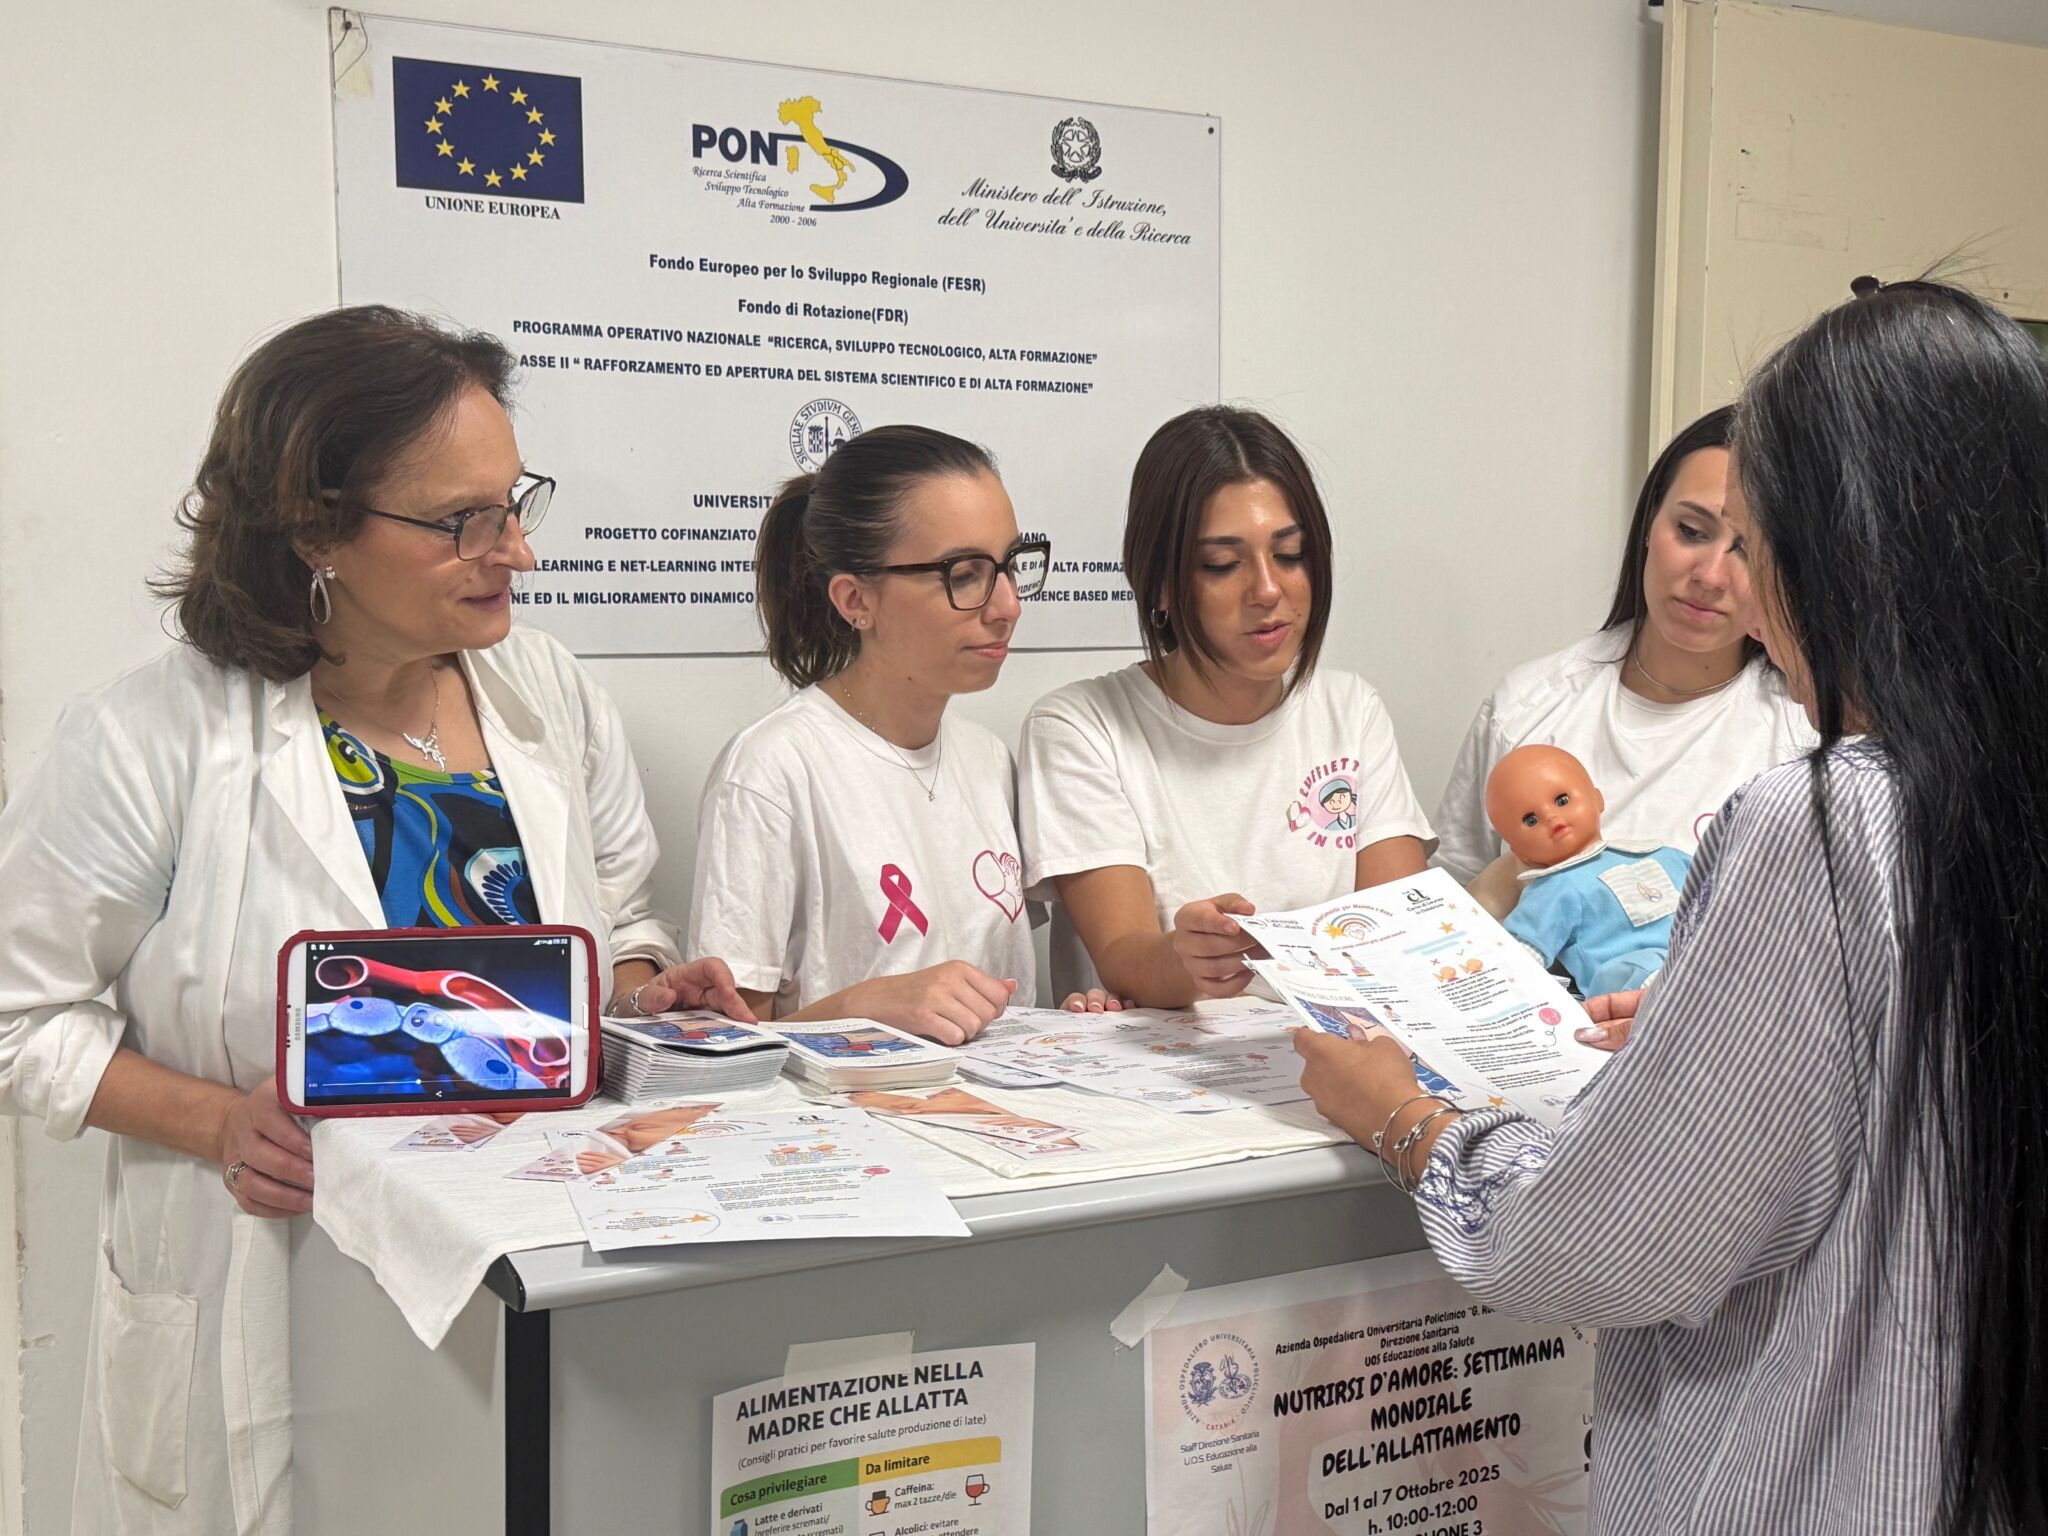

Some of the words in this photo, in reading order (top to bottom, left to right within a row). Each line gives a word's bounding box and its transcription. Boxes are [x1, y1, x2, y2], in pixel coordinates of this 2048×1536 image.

[692, 123, 778, 166] PON
[693, 166, 722, 178] Ricerca
[724, 169, 767, 183] Scientifica
[704, 181, 741, 196] Sviluppo
[743, 184, 789, 199] Tecnologico
[961, 178, 1038, 203] Ministero
[1082, 189, 1166, 217] Istruzione,
[425, 196, 484, 214] UNIONE
[488, 201, 561, 220] EUROPEA
[737, 198, 756, 209] Alta
[758, 200, 805, 212] Formazione
[770, 215, 790, 225] 2000
[797, 217, 817, 227] 2006
[1074, 226, 1082, 236] e
[1086, 220, 1125, 240] della
[1129, 221, 1191, 245] Ricerca
[649, 254, 694, 271] Fondo
[699, 258, 759, 280] Europeo
[763, 265, 786, 281] per
[791, 266, 804, 279] lo
[808, 266, 867, 287] Sviluppo
[871, 271, 938, 290] Regionale
[942, 276, 986, 295] (FESR)
[738, 299, 781, 316] Fondo
[785, 302, 798, 317] di
[803, 303, 909, 326] Rotazione(FDR)
[513, 320, 603, 337] PROGRAMMA
[607, 326, 682, 342] OPERATIVO
[687, 331, 761, 347] NAZIONALE
[836, 339, 895, 354] SVILUPPO
[898, 343, 985, 361] TECNOLOGICO,
[989, 346, 1017, 360] ALTA
[520, 355, 555, 368] ASSE
[584, 358, 701, 375] RAFFORZAMENTO
[705, 362, 722, 376] ED
[726, 363, 794, 381] APERTURA
[797, 367, 821, 382] DEL
[825, 368, 877, 385] SISTEMA
[881, 371, 955, 390] SCIENTIFICO
[959, 376, 967, 389] E
[970, 377, 982, 390] DI
[985, 378, 1013, 392] ALTA
[792, 420, 807, 464] SICILIAE
[801, 401, 841, 420] STVDIVM
[585, 527, 656, 540] PROGETTO
[661, 528, 757, 541] COFINANZIATO
[608, 560, 616, 571] E
[620, 560, 717, 573] NET-LEARNING
[1052, 561, 1079, 573] ALTA
[534, 592, 552, 604] ED
[557, 592, 569, 604] IL
[573, 591, 687, 605] MIGLIORAMENTO
[690, 592, 755, 604] DINAMICO
[1073, 590, 1108, 602] BASED
[1306, 831, 1328, 848] IN
[1335, 833, 1357, 849] CO
[1275, 1338, 1311, 1355] Azienda
[1313, 1329, 1364, 1349] Ospedaliera
[1367, 1317, 1422, 1337] Universitaria
[1425, 1309, 1466, 1326] Policlinico
[1380, 1333, 1421, 1349] Direzione
[1422, 1325, 1459, 1341] Sanitaria
[1365, 1355, 1381, 1367] UOS
[1383, 1345, 1429, 1364] Educazione
[1432, 1340, 1447, 1354] alla
[1449, 1335, 1475, 1351] Salute
[1273, 1377, 1365, 1417] NUTRIRSI
[1370, 1357, 1458, 1397] D'AMORE:
[1463, 1336, 1565, 1378] SETTIMANA
[736, 1373, 909, 1421] ALIMENTAZIONE
[914, 1360, 983, 1385] NELLA
[747, 1410, 824, 1445] MADRE
[830, 1402, 871, 1426] CHE
[876, 1388, 968, 1419] ALLATTA
[1371, 1387, 1473, 1431] MONDIALE
[738, 1445, 776, 1470] (Consigli
[778, 1441, 808, 1459] pratici
[811, 1441, 826, 1455] per
[829, 1434, 865, 1449] favorire
[867, 1428, 896, 1441] salute
[898, 1419, 950, 1437] produzione
[953, 1416, 963, 1427] di
[964, 1414, 986, 1427] late)
[1180, 1443, 1198, 1453] Staff
[1198, 1437, 1230, 1450] Direzione
[1231, 1431, 1260, 1442] Sanitaria
[1206, 1447, 1245, 1461] Educazione
[1246, 1444, 1258, 1454] alla
[1322, 1412, 1521, 1477] DELL'ALLATTAMENTO
[865, 1463, 881, 1475] Da
[885, 1454, 929, 1472] limitare
[1211, 1463, 1233, 1474] Salute
[730, 1490, 756, 1505] Cosa
[759, 1474, 827, 1500] privilegiare
[894, 1499, 912, 1510] max
[913, 1497, 918, 1506] 2
[919, 1491, 957, 1505] tazze/die
[895, 1482, 934, 1497] Caffeina:
[1325, 1498, 1349, 1519] Dal
[1353, 1495, 1359, 1511] 1
[1363, 1491, 1378, 1510] al
[1382, 1488, 1392, 1505] 7
[1396, 1475, 1454, 1501] Ottobre
[1458, 1465, 1500, 1487] 2025
[755, 1514, 778, 1527] Latte
[788, 1503, 823, 1519] derivati
[930, 1519, 959, 1530] evitare
[1368, 1518, 1383, 1536] h.
[1387, 1495, 1478, 1532] 10:00-12:00
[1415, 1522, 1469, 1536] ONE
[1473, 1519, 1483, 1536] 3
